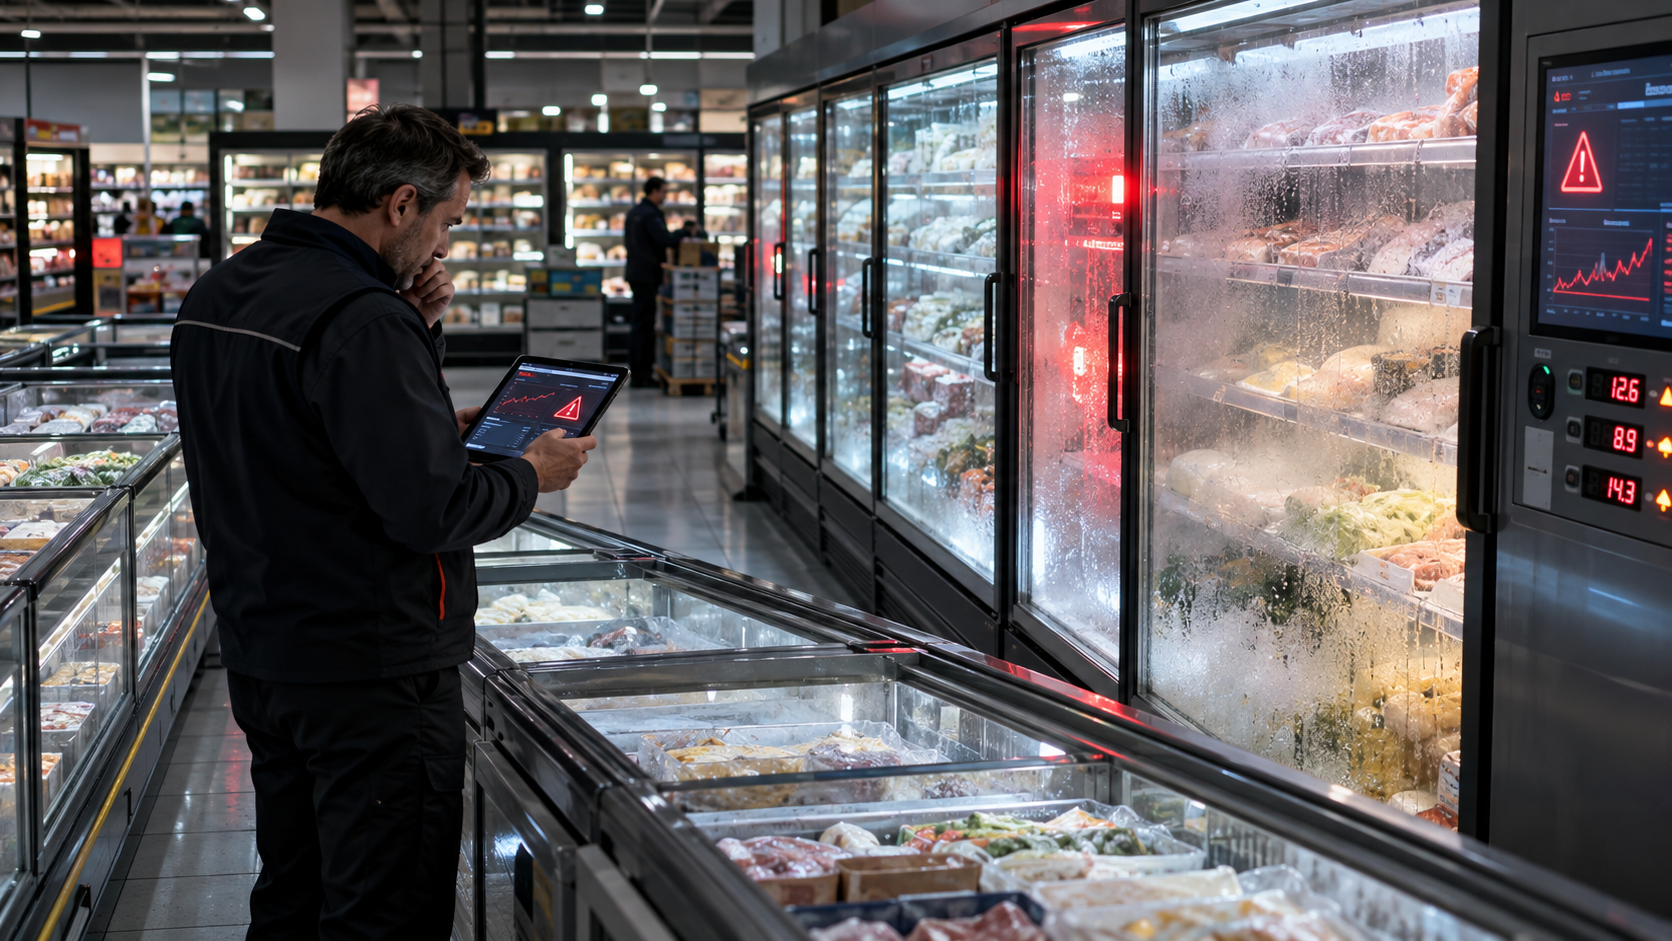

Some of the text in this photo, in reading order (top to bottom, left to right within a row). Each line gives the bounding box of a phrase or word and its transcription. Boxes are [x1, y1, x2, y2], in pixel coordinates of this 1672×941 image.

[1611, 377, 1639, 402] 12.6
[1613, 426, 1637, 453] 8.9
[1607, 477, 1636, 504] 14.3
